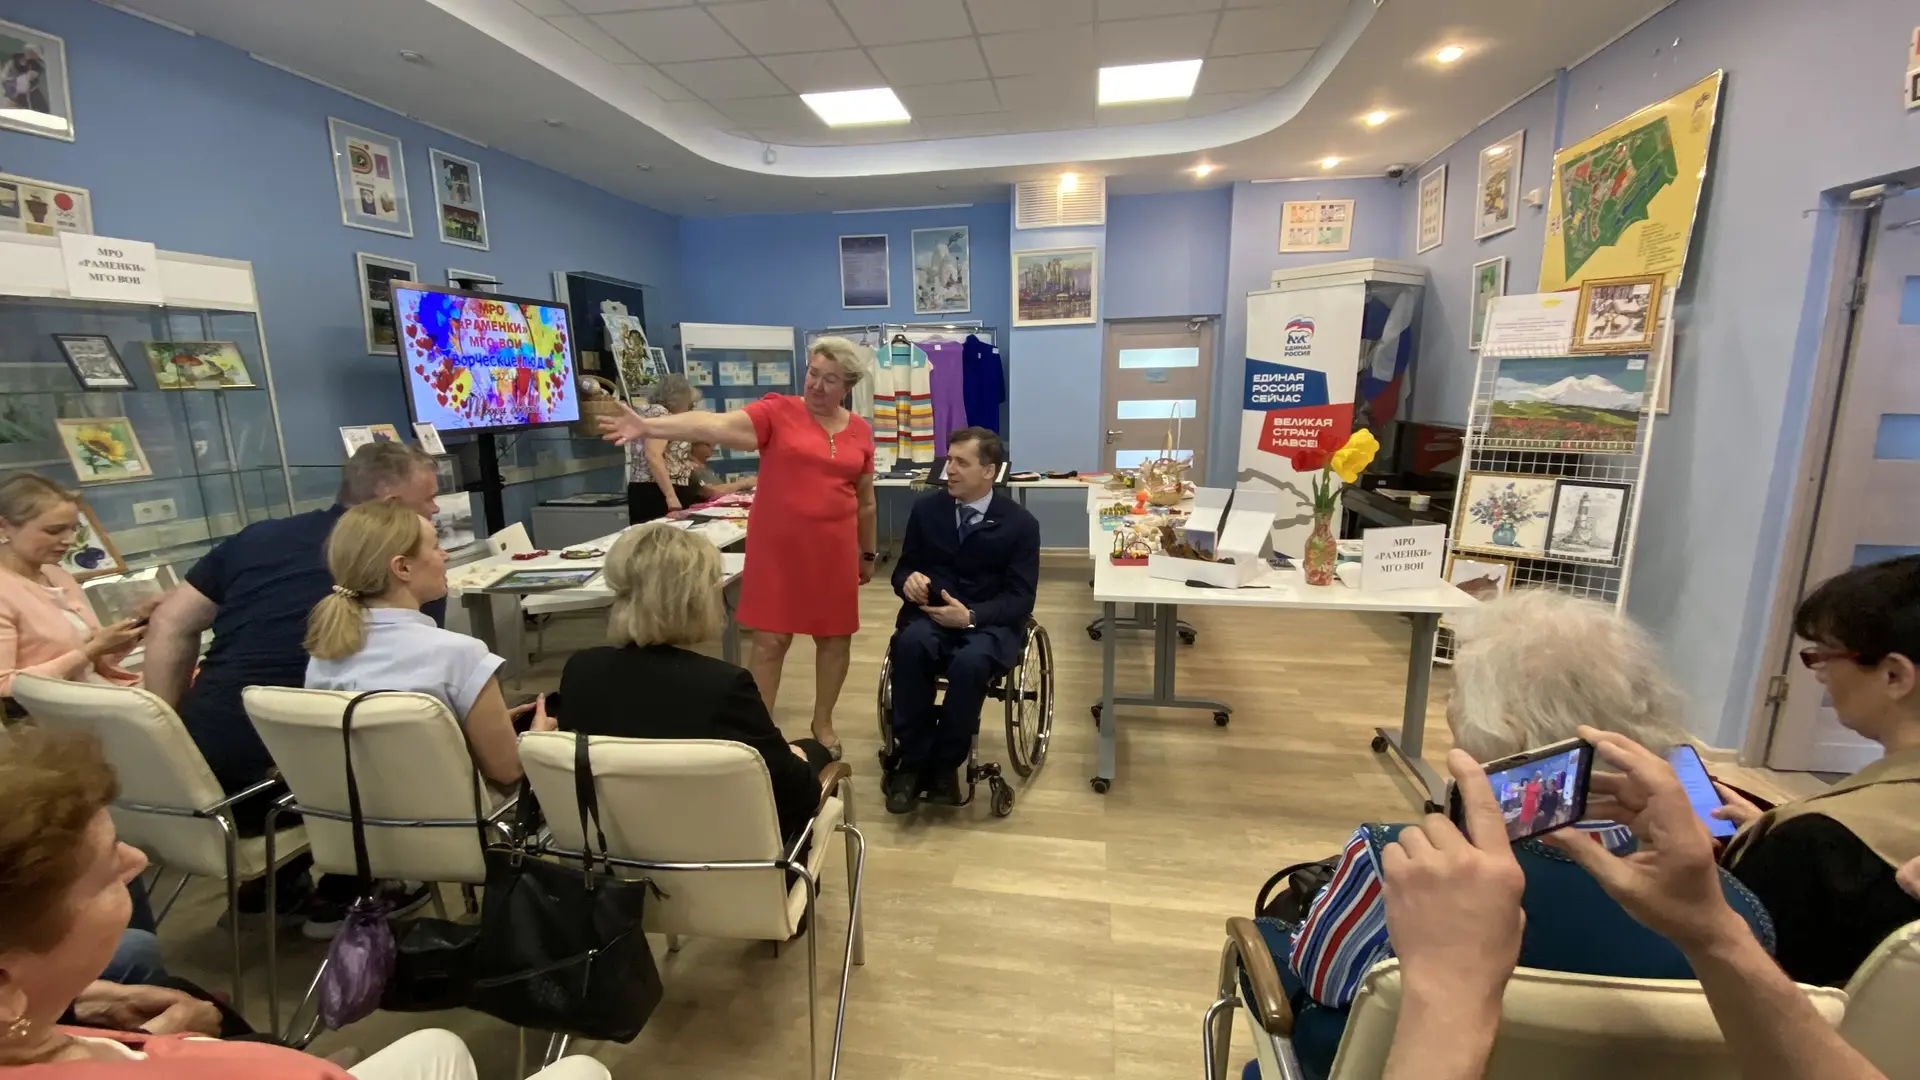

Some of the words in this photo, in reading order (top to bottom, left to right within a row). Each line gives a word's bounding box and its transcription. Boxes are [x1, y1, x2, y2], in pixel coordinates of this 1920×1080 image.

[97, 247, 123, 258] МРО
[88, 272, 115, 283] МГО
[117, 275, 141, 285] ВОИ
[479, 302, 504, 316] МРО
[500, 337, 522, 349] ВОИ
[450, 352, 518, 371] ворческие
[1252, 372, 1305, 383] ЕДИНАЯ
[1252, 383, 1305, 393] РОССИЯ
[1251, 393, 1301, 403] СЕЙЧАС
[1273, 417, 1333, 427] ВЕЛИКАЯ
[1393, 537, 1416, 547] МРО
[1374, 549, 1432, 560] «РАМЕНКИ»
[1380, 563, 1402, 573] МГО
[1404, 562, 1424, 572] ВОИ
